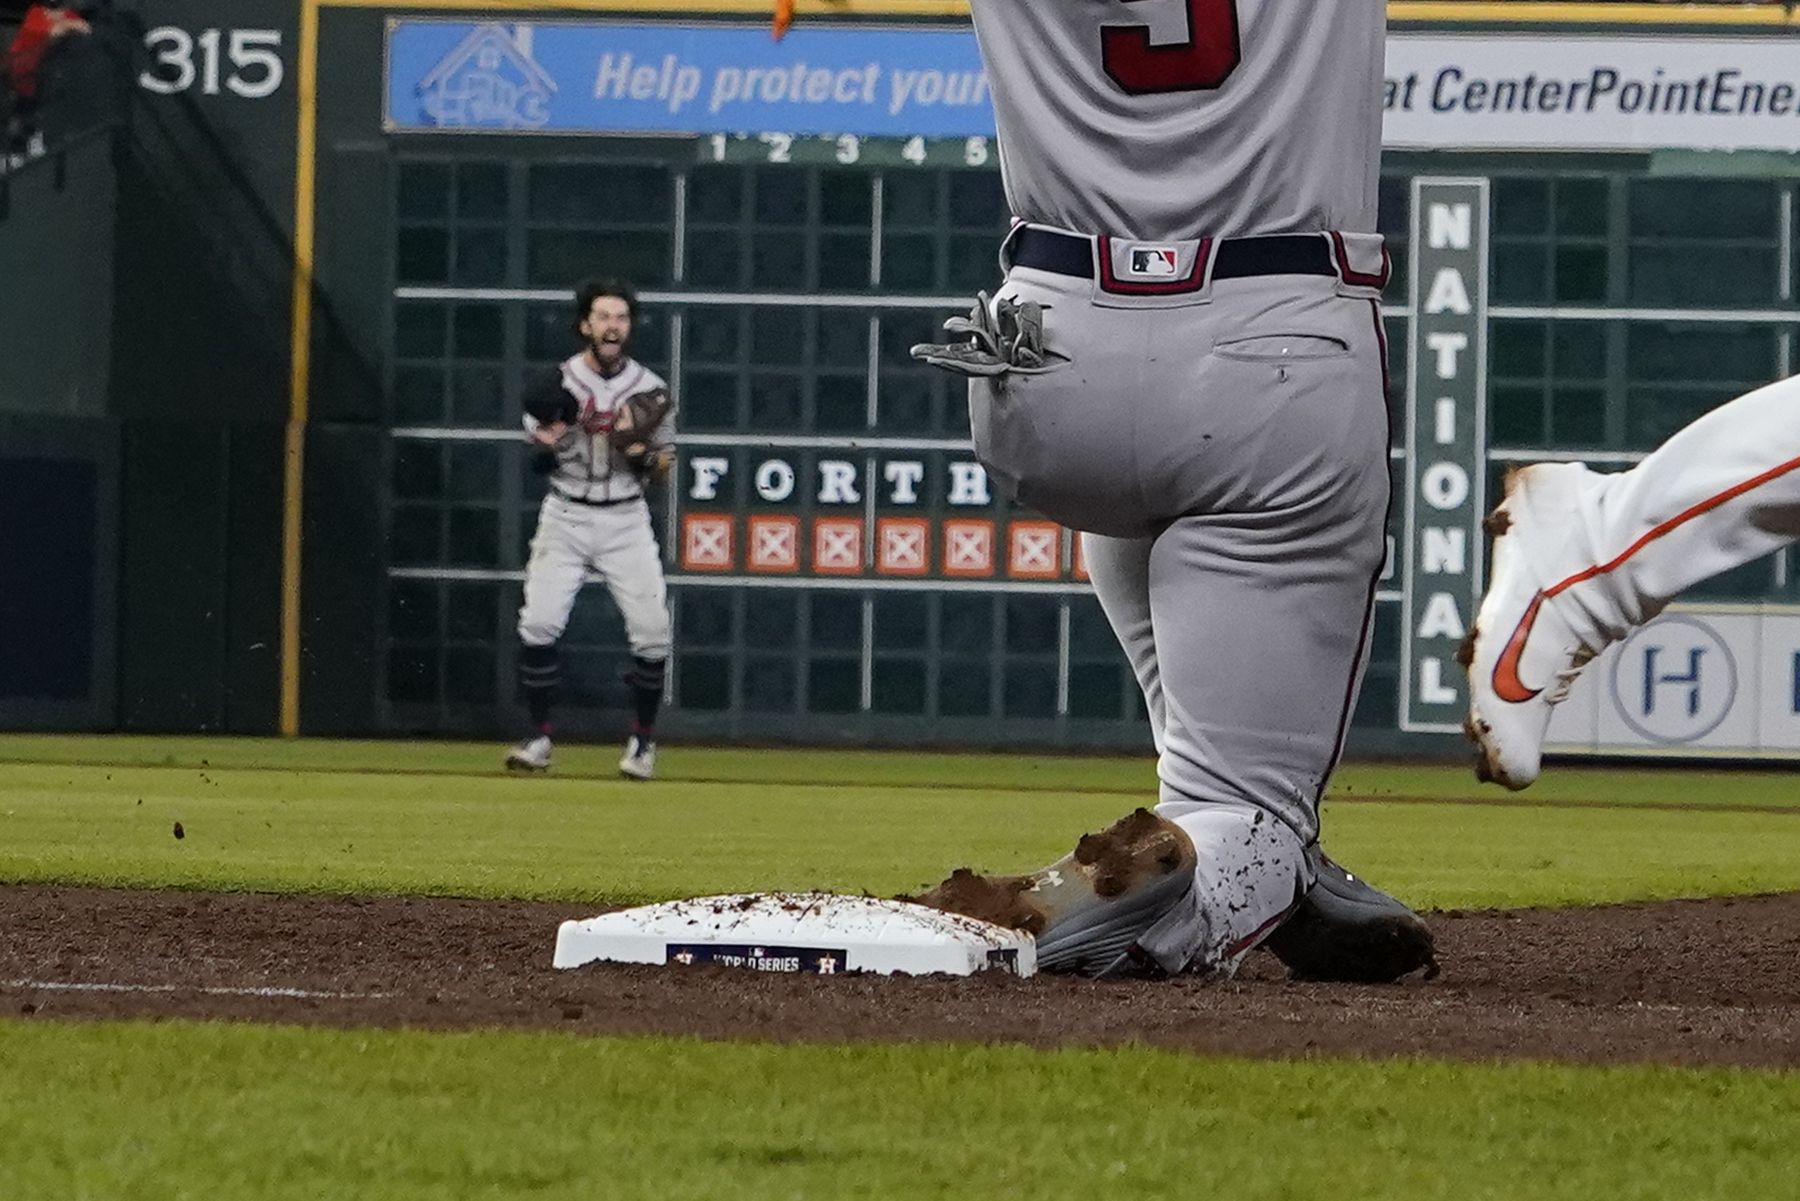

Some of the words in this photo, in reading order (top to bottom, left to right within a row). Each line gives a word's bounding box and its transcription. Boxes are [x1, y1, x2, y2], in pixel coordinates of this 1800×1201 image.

[139, 26, 285, 99] 315
[594, 51, 700, 114] Help
[708, 61, 881, 114] protect
[888, 69, 990, 116] your
[709, 134, 728, 163] 1
[767, 134, 793, 164] 2
[835, 134, 861, 164] 3
[902, 135, 928, 166] 4
[1418, 202, 1472, 705] NATIONAL
[757, 956, 800, 972] SERIES
